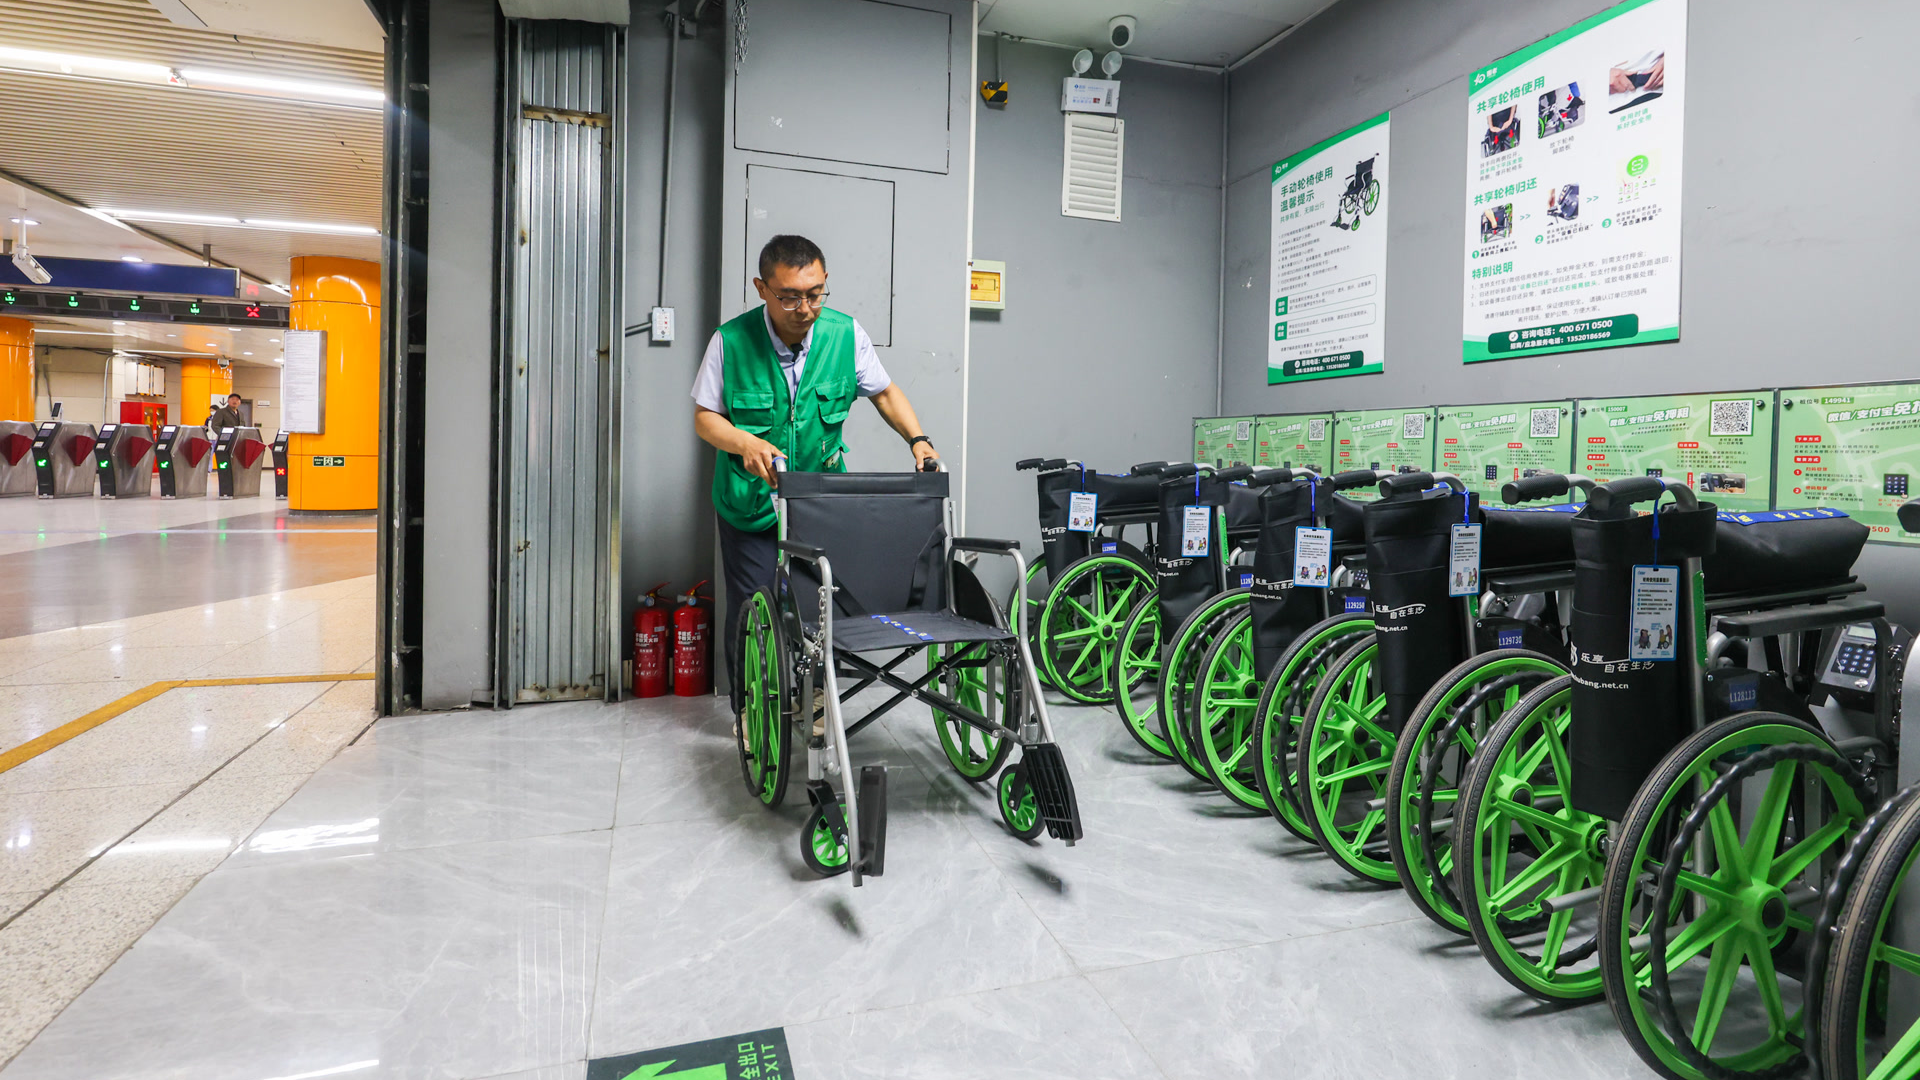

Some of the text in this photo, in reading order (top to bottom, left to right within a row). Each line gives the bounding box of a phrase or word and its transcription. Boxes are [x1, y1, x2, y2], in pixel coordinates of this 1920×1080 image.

[1476, 76, 1546, 114] 共享轮椅使用
[1281, 166, 1333, 198] 手动轮椅使用
[1473, 177, 1538, 206] 共享轮椅归还
[1280, 189, 1315, 213] 温馨提示
[1472, 261, 1513, 280] 特别说明
[1559, 325, 1574, 334] 400
[1575, 323, 1590, 332] 671
[1591, 320, 1613, 330] 0500
[1567, 332, 1611, 343] 13520186569
[1498, 634, 1523, 647] L129730
[1581, 653, 1604, 663] 乐享
[1730, 690, 1756, 703] L128113
